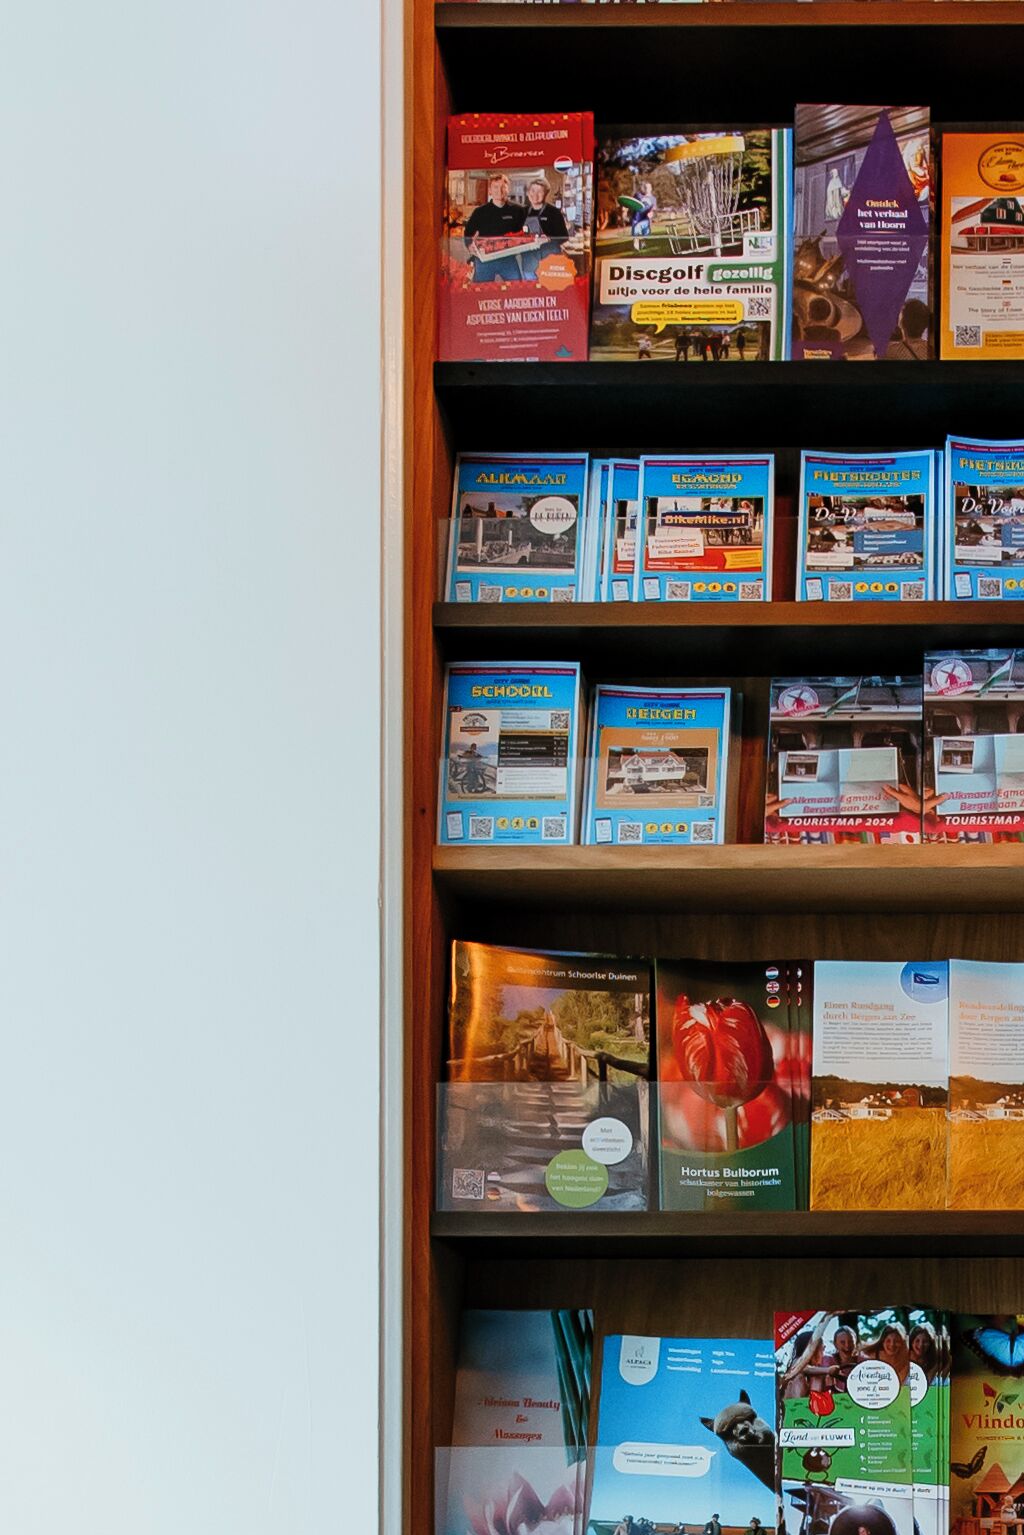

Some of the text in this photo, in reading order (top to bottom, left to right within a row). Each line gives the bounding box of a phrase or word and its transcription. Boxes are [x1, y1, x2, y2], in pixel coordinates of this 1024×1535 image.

[865, 199, 899, 208] Ontdek
[857, 209, 908, 218] het verhaal
[860, 221, 906, 229] van Hoorn
[609, 265, 773, 283] Discgolf gezellig
[608, 285, 772, 297] uitje voor de hele familie
[478, 296, 556, 311] VERSE AARDBEIEN EN
[467, 314, 505, 326] ASPERGES
[506, 312, 522, 323] VAN
[523, 310, 544, 322] EIGEN
[961, 497, 983, 514] De
[471, 685, 552, 698] SCHOORL
[626, 708, 696, 720] BERGEN
[945, 816, 1021, 825] TOURISTMAP
[568, 970, 606, 979] Schoorlse
[608, 972, 637, 981] Duinen
[824, 1001, 895, 1012] Einen Rundgang
[823, 1011, 848, 1020] durch
[681, 1167, 779, 1178] Hortus Bulborum
[741, 1177, 782, 1186] historische
[782, 1431, 808, 1444] Land
